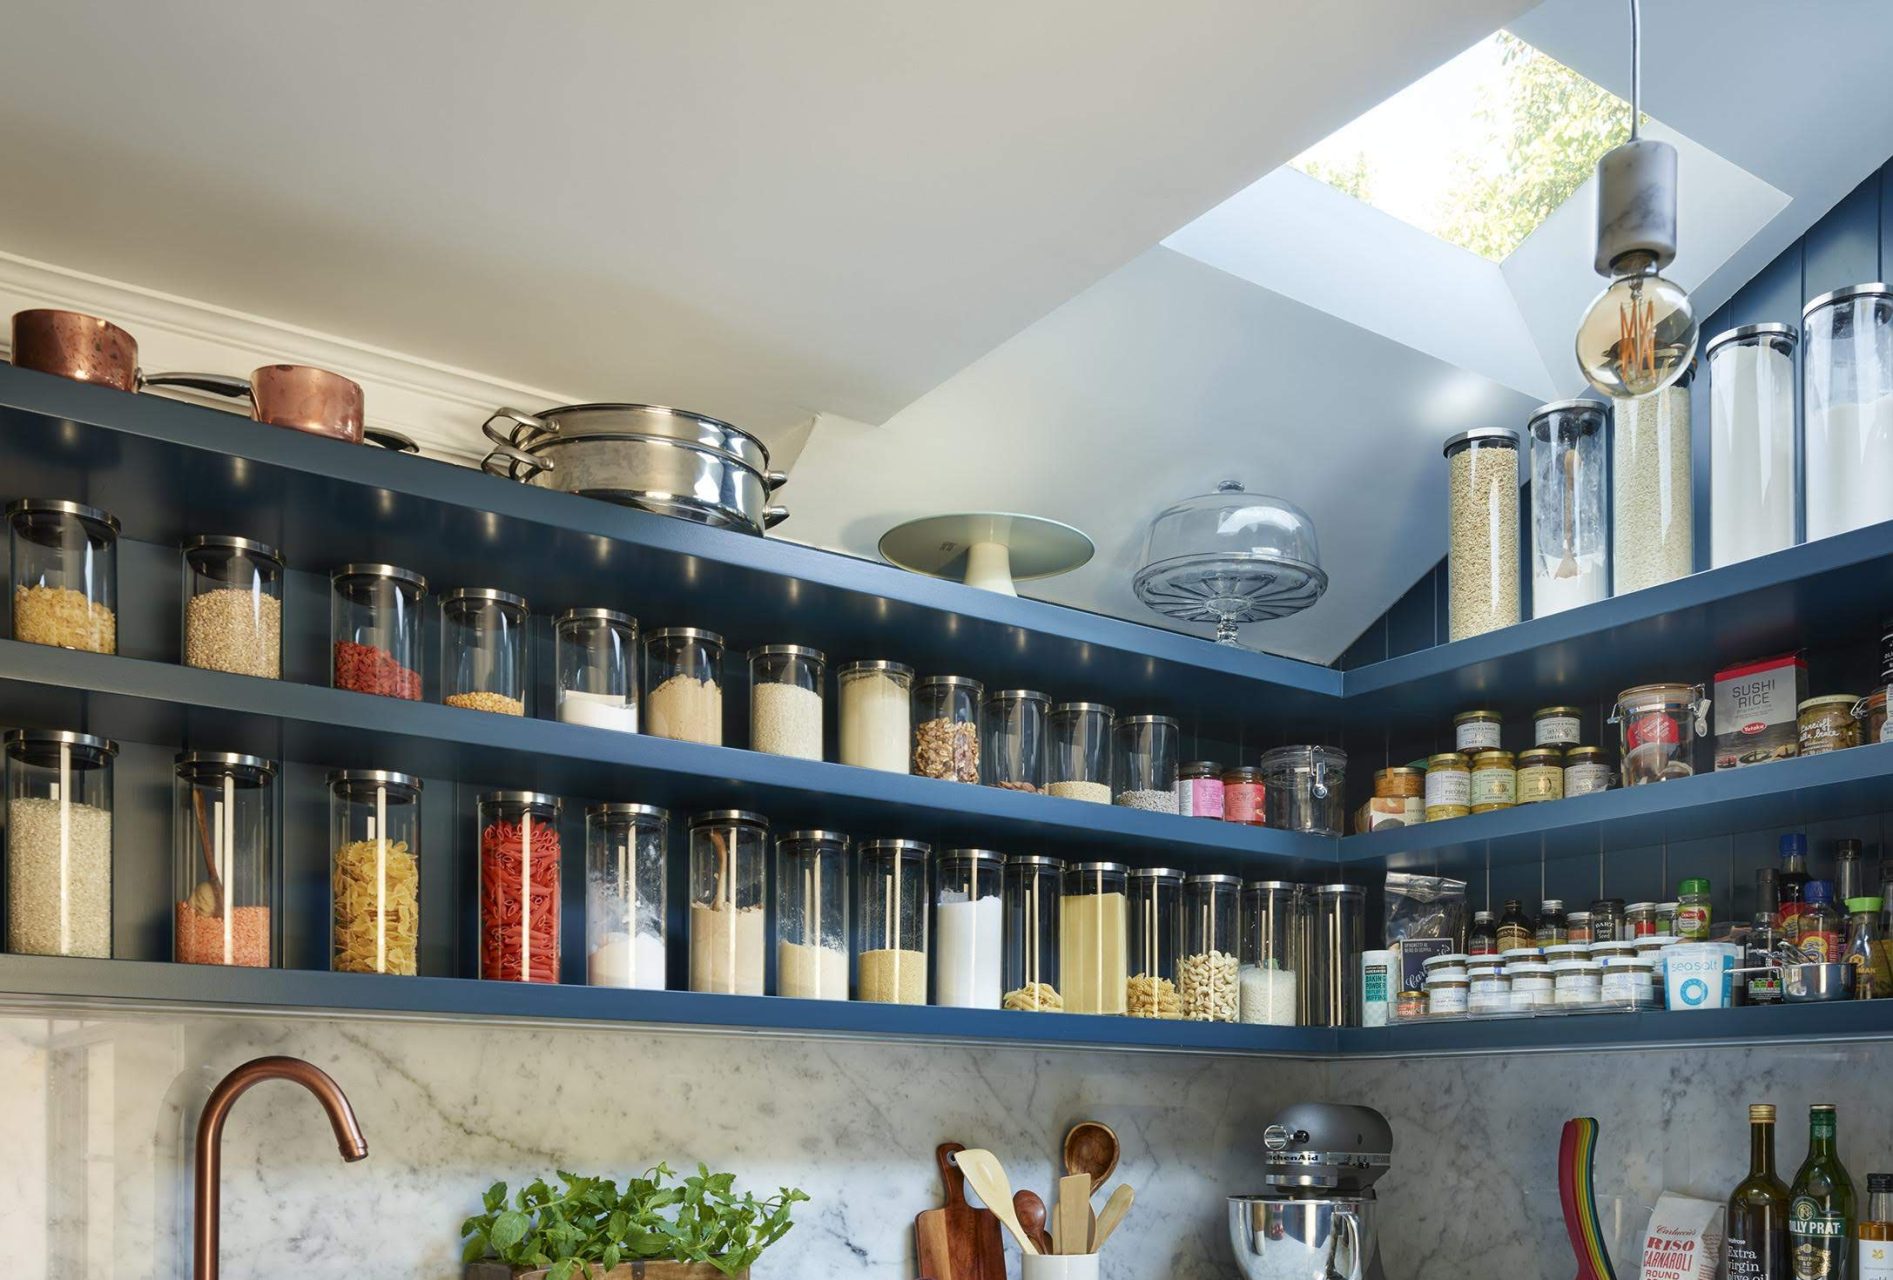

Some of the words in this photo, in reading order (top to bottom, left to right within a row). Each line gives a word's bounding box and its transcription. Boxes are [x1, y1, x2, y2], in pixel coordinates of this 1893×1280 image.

[1732, 679, 1775, 698] SUSHI
[1738, 692, 1770, 708] RICE
[1671, 962, 1693, 972] sea
[1694, 960, 1718, 971] salt
[1809, 1221, 1838, 1234] PRAT
[1647, 1237, 1695, 1251] RISO
[1727, 1245, 1757, 1259] Extra
[1643, 1250, 1693, 1272] CARNAROLI
[1727, 1259, 1760, 1274] virgin
[1645, 1270, 1680, 1280] ROUND
